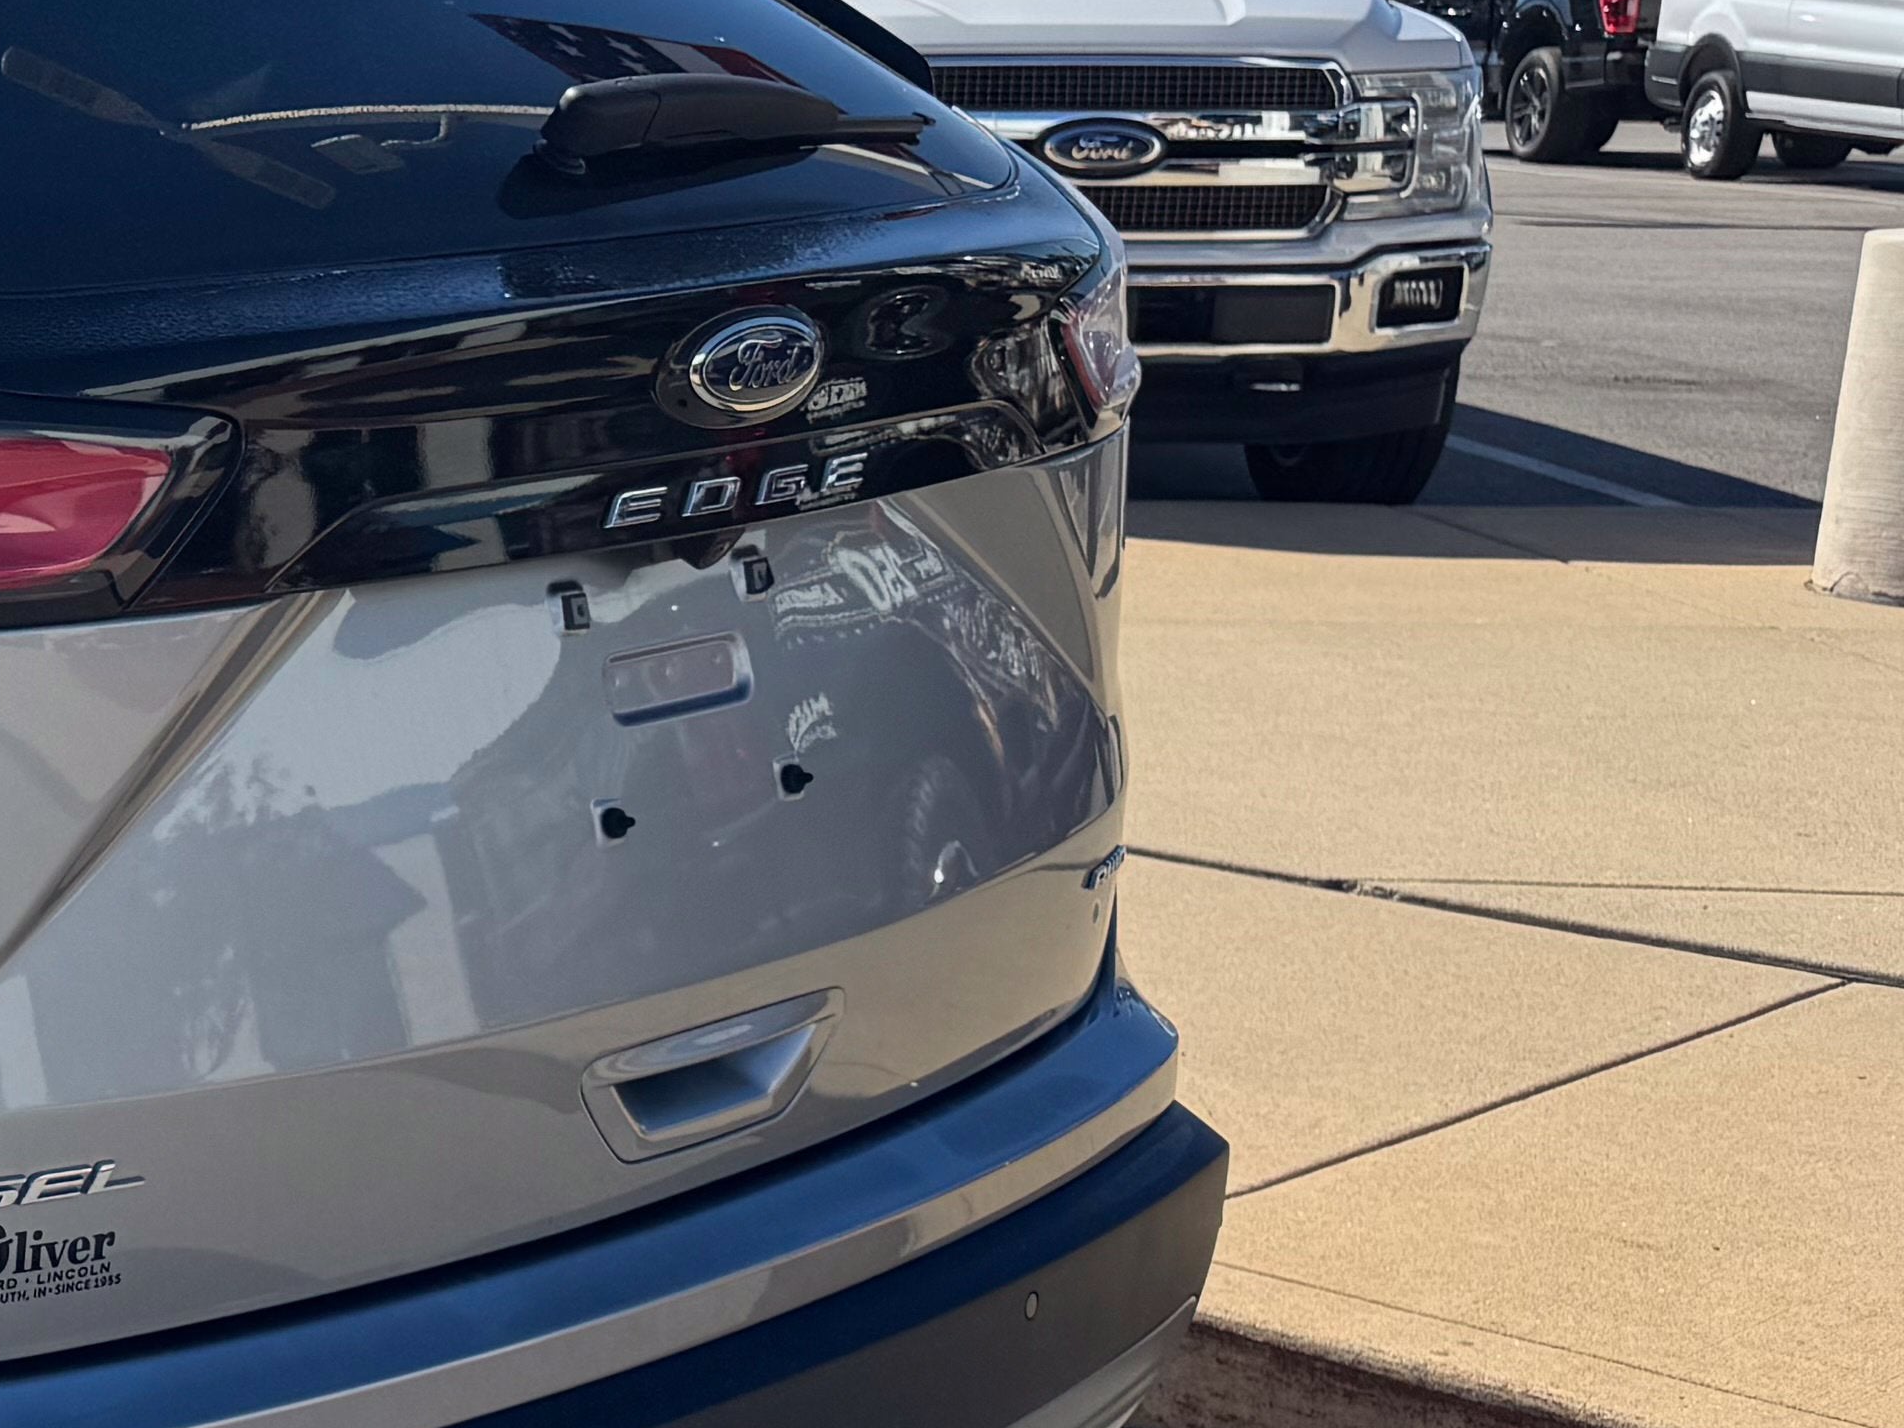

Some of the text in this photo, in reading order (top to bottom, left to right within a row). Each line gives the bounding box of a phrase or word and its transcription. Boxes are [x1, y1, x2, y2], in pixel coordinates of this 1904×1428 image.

[1071, 134, 1135, 161] Ford
[729, 333, 800, 391] Ford
[603, 453, 868, 529] EDGE
[36, 1261, 112, 1285] LINCOLN
